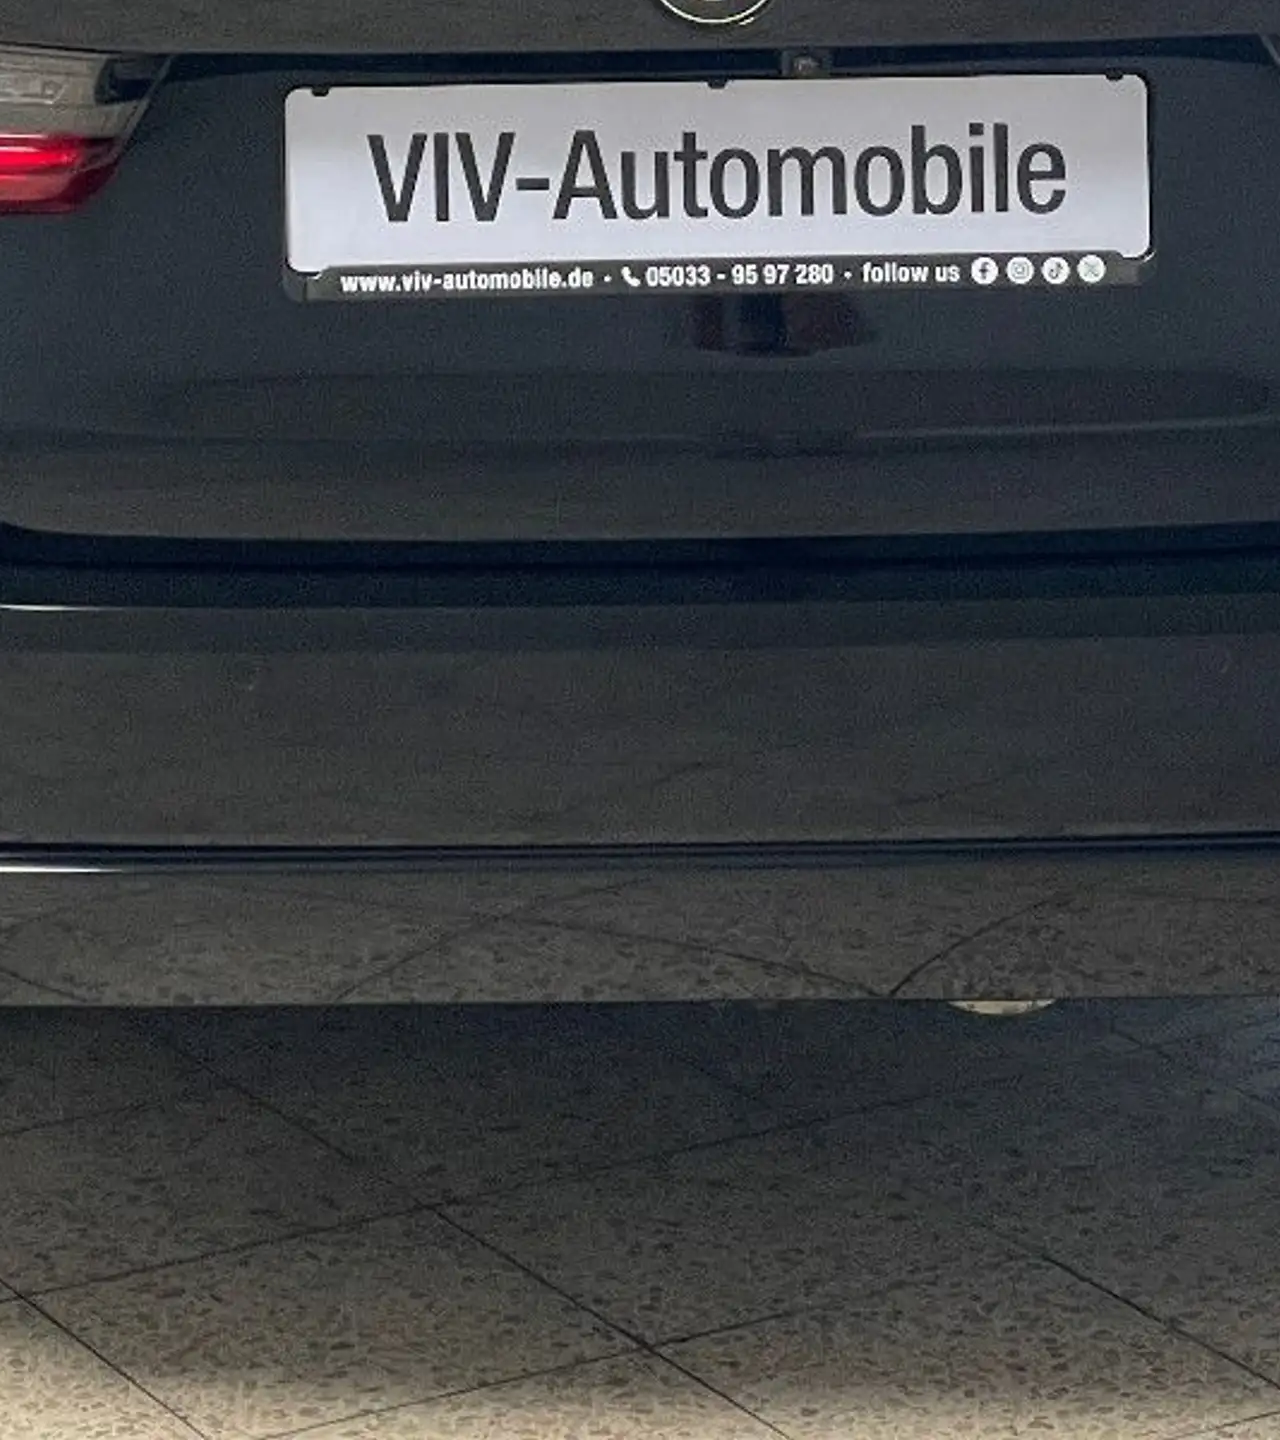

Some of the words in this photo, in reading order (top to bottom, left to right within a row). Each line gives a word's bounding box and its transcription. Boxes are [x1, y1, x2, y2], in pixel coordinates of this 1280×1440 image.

[368, 122, 1066, 222] VIV-Automobile
[339, 265, 595, 293] www.viv-automobile.de
[644, 264, 711, 288] 05033
[731, 263, 759, 285] 95
[762, 263, 790, 285] 97
[793, 262, 835, 285] 280
[862, 261, 930, 284] follow
[934, 263, 961, 283] us
